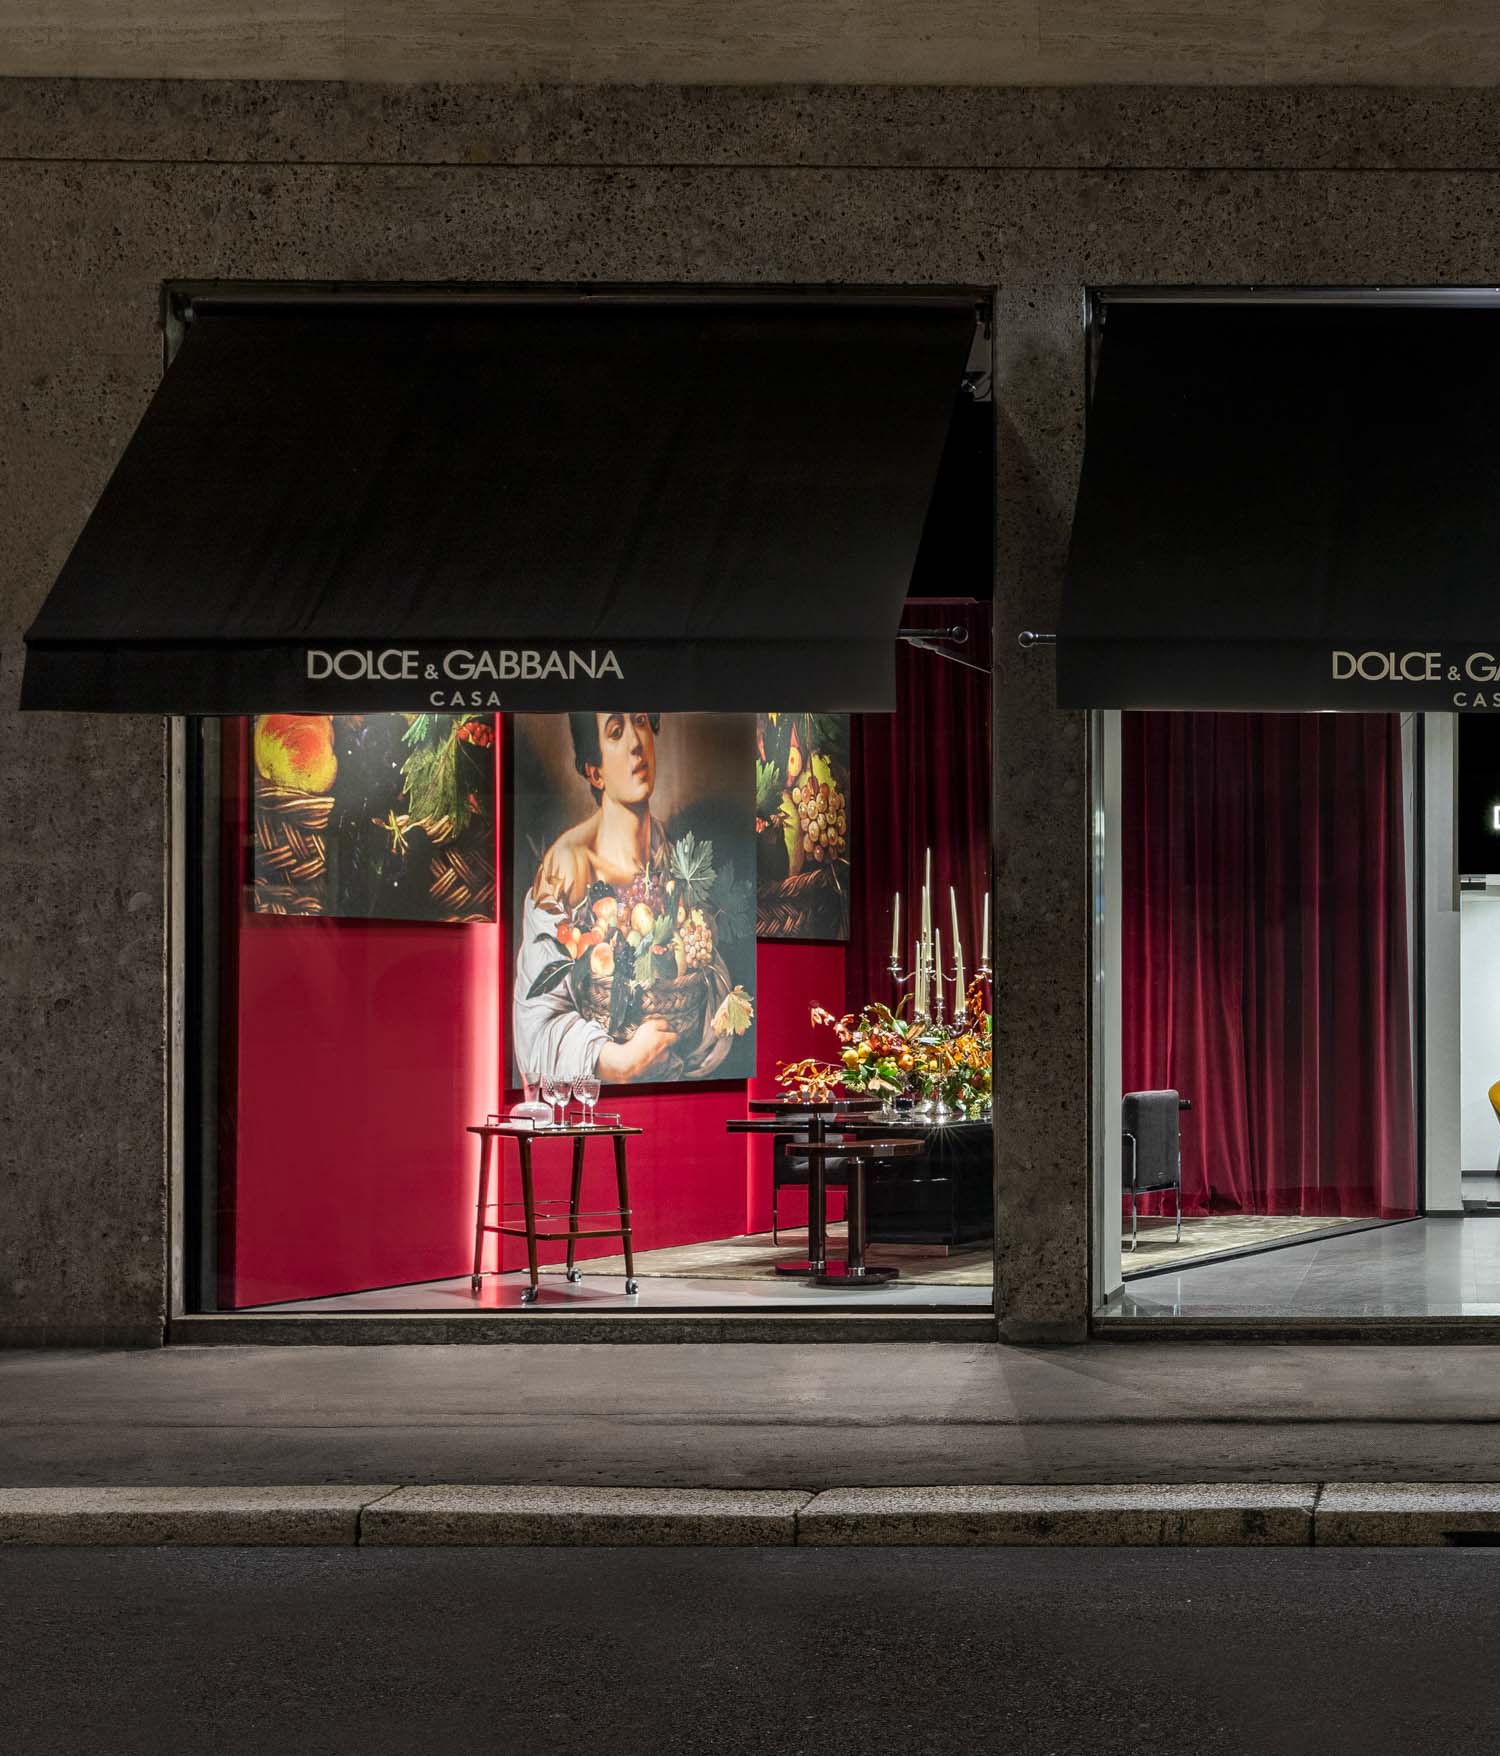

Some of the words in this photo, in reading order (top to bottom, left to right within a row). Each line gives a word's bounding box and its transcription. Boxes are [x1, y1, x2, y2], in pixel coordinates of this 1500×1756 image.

[307, 650, 419, 680] DOLCE
[425, 664, 439, 680] &
[443, 650, 624, 680] GABBANA
[1332, 651, 1442, 681] DOLCE
[1447, 666, 1461, 681] &
[430, 690, 501, 707] CASA
